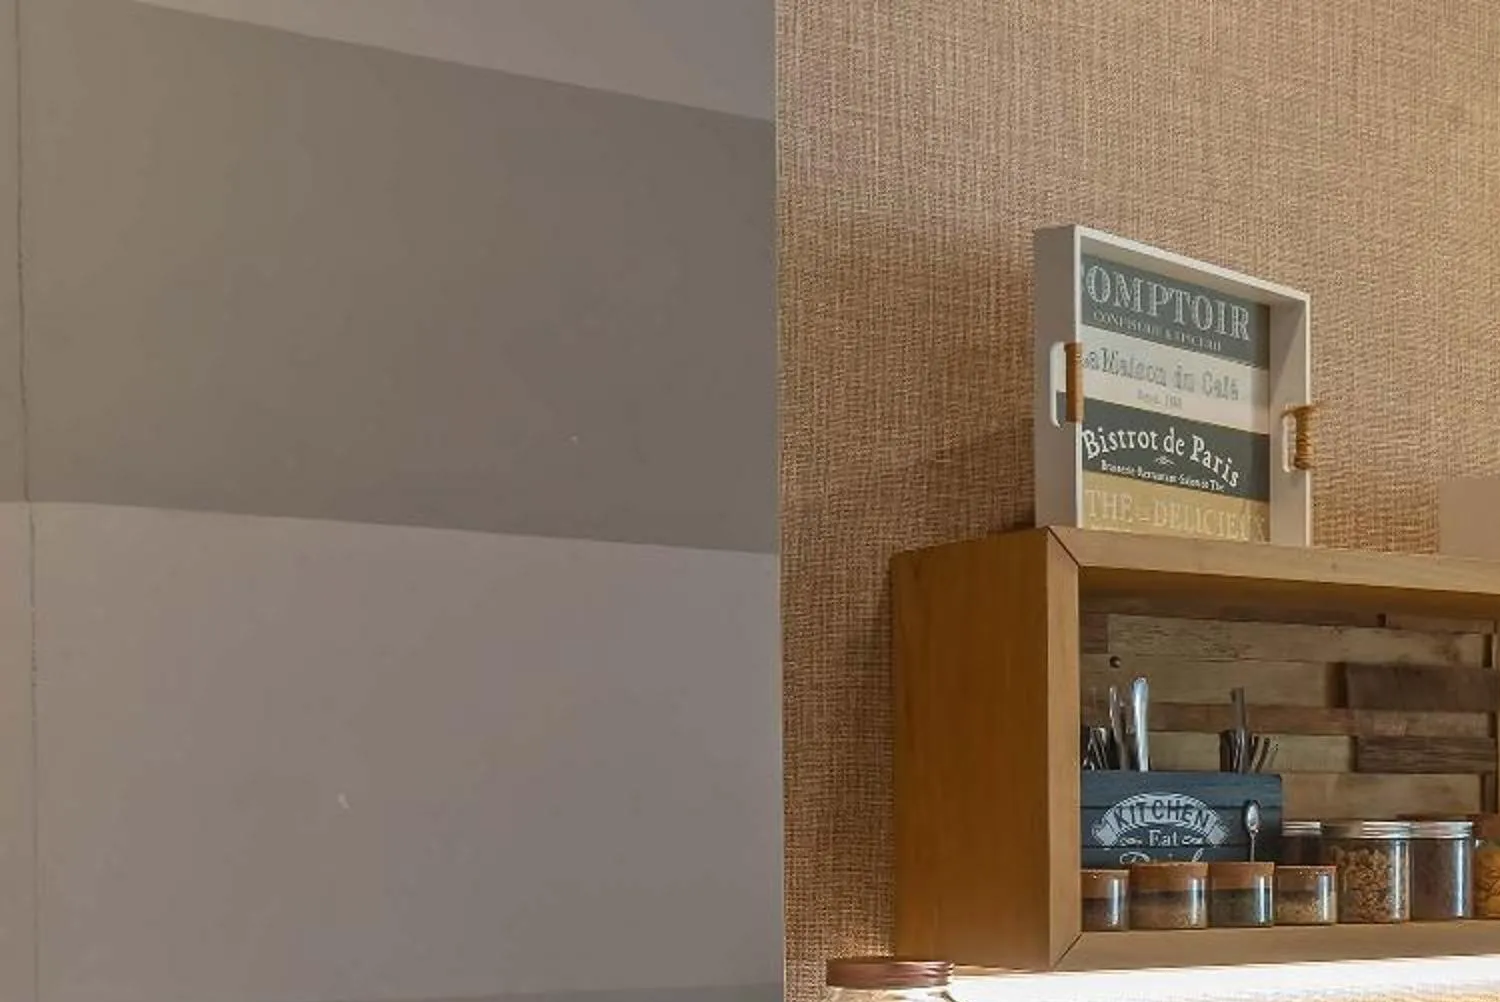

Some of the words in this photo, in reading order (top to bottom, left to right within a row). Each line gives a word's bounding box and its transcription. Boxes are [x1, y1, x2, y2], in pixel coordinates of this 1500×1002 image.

[1081, 264, 1250, 341] OMPTOIR
[1082, 426, 1159, 461] Bistrot
[1163, 426, 1185, 456] de
[1189, 435, 1239, 488] Paris
[1112, 799, 1211, 828] KITCHEN
[1148, 829, 1180, 846] Eat
